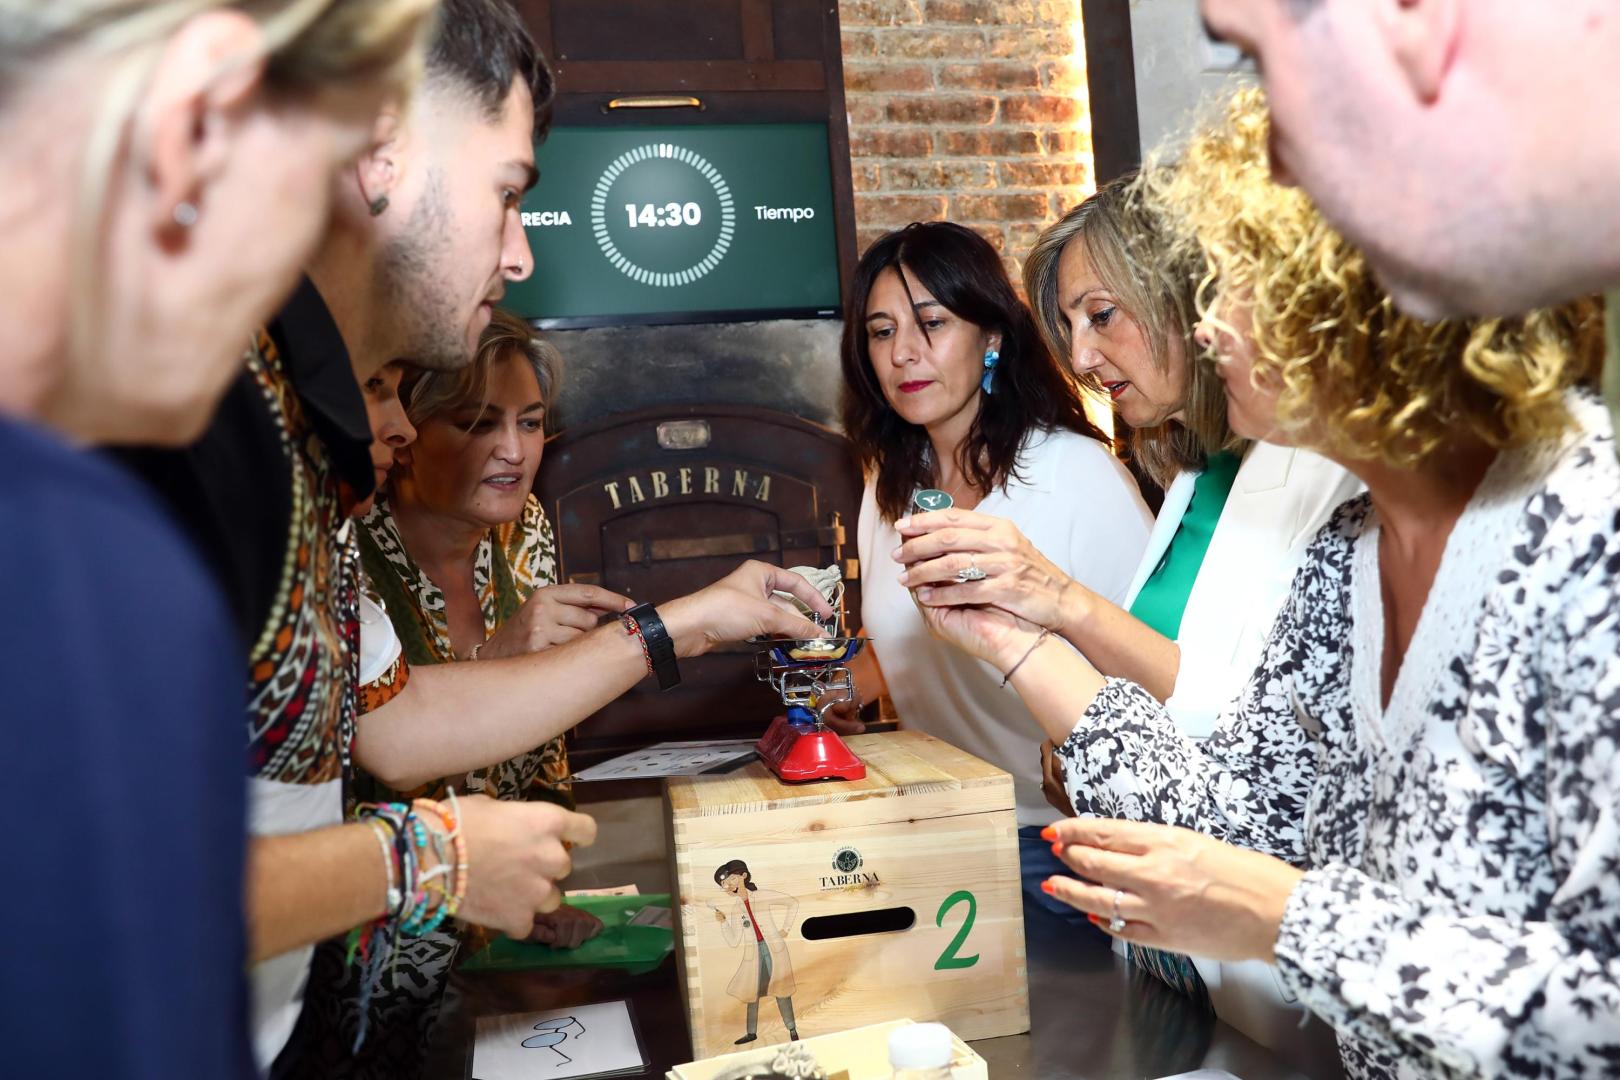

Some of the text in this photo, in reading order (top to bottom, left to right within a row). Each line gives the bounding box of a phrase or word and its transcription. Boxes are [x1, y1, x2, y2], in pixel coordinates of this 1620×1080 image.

[521, 211, 572, 227] RECIA
[625, 202, 701, 228] 14:30
[754, 205, 815, 223] Tiempo
[604, 467, 771, 510] TABERNA
[819, 872, 880, 887] TABERNA
[935, 890, 980, 970] 2
